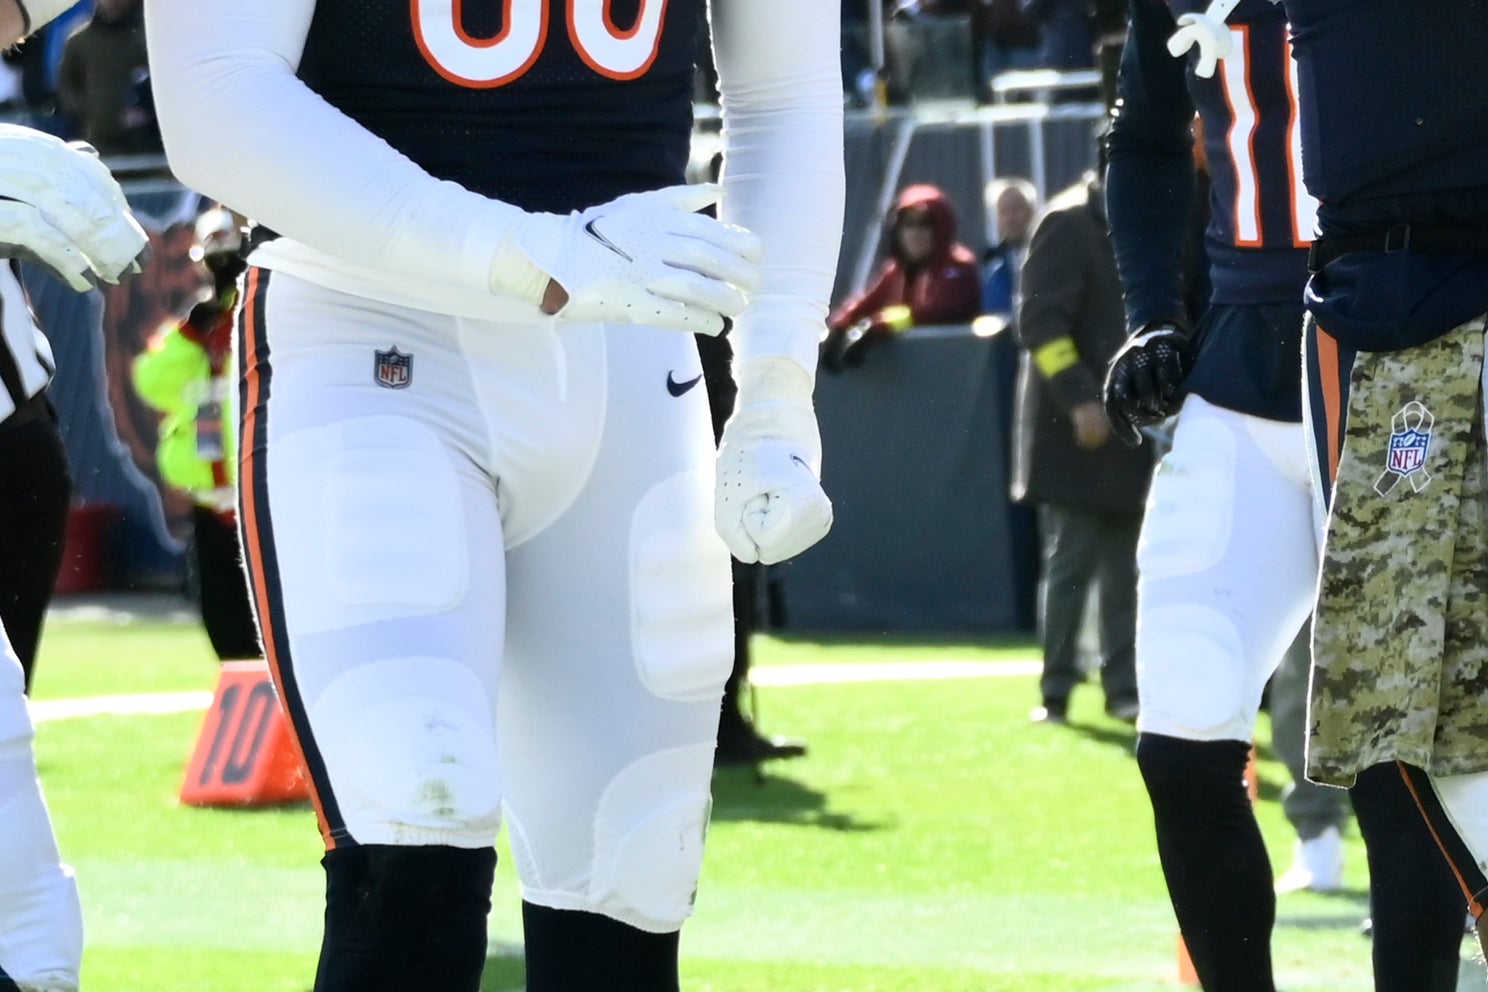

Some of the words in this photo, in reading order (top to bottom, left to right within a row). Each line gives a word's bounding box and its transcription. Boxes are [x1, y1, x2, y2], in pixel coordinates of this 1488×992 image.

[380, 364, 407, 383] NFL
[1392, 448, 1424, 470] NFL
[199, 681, 277, 787] 10
